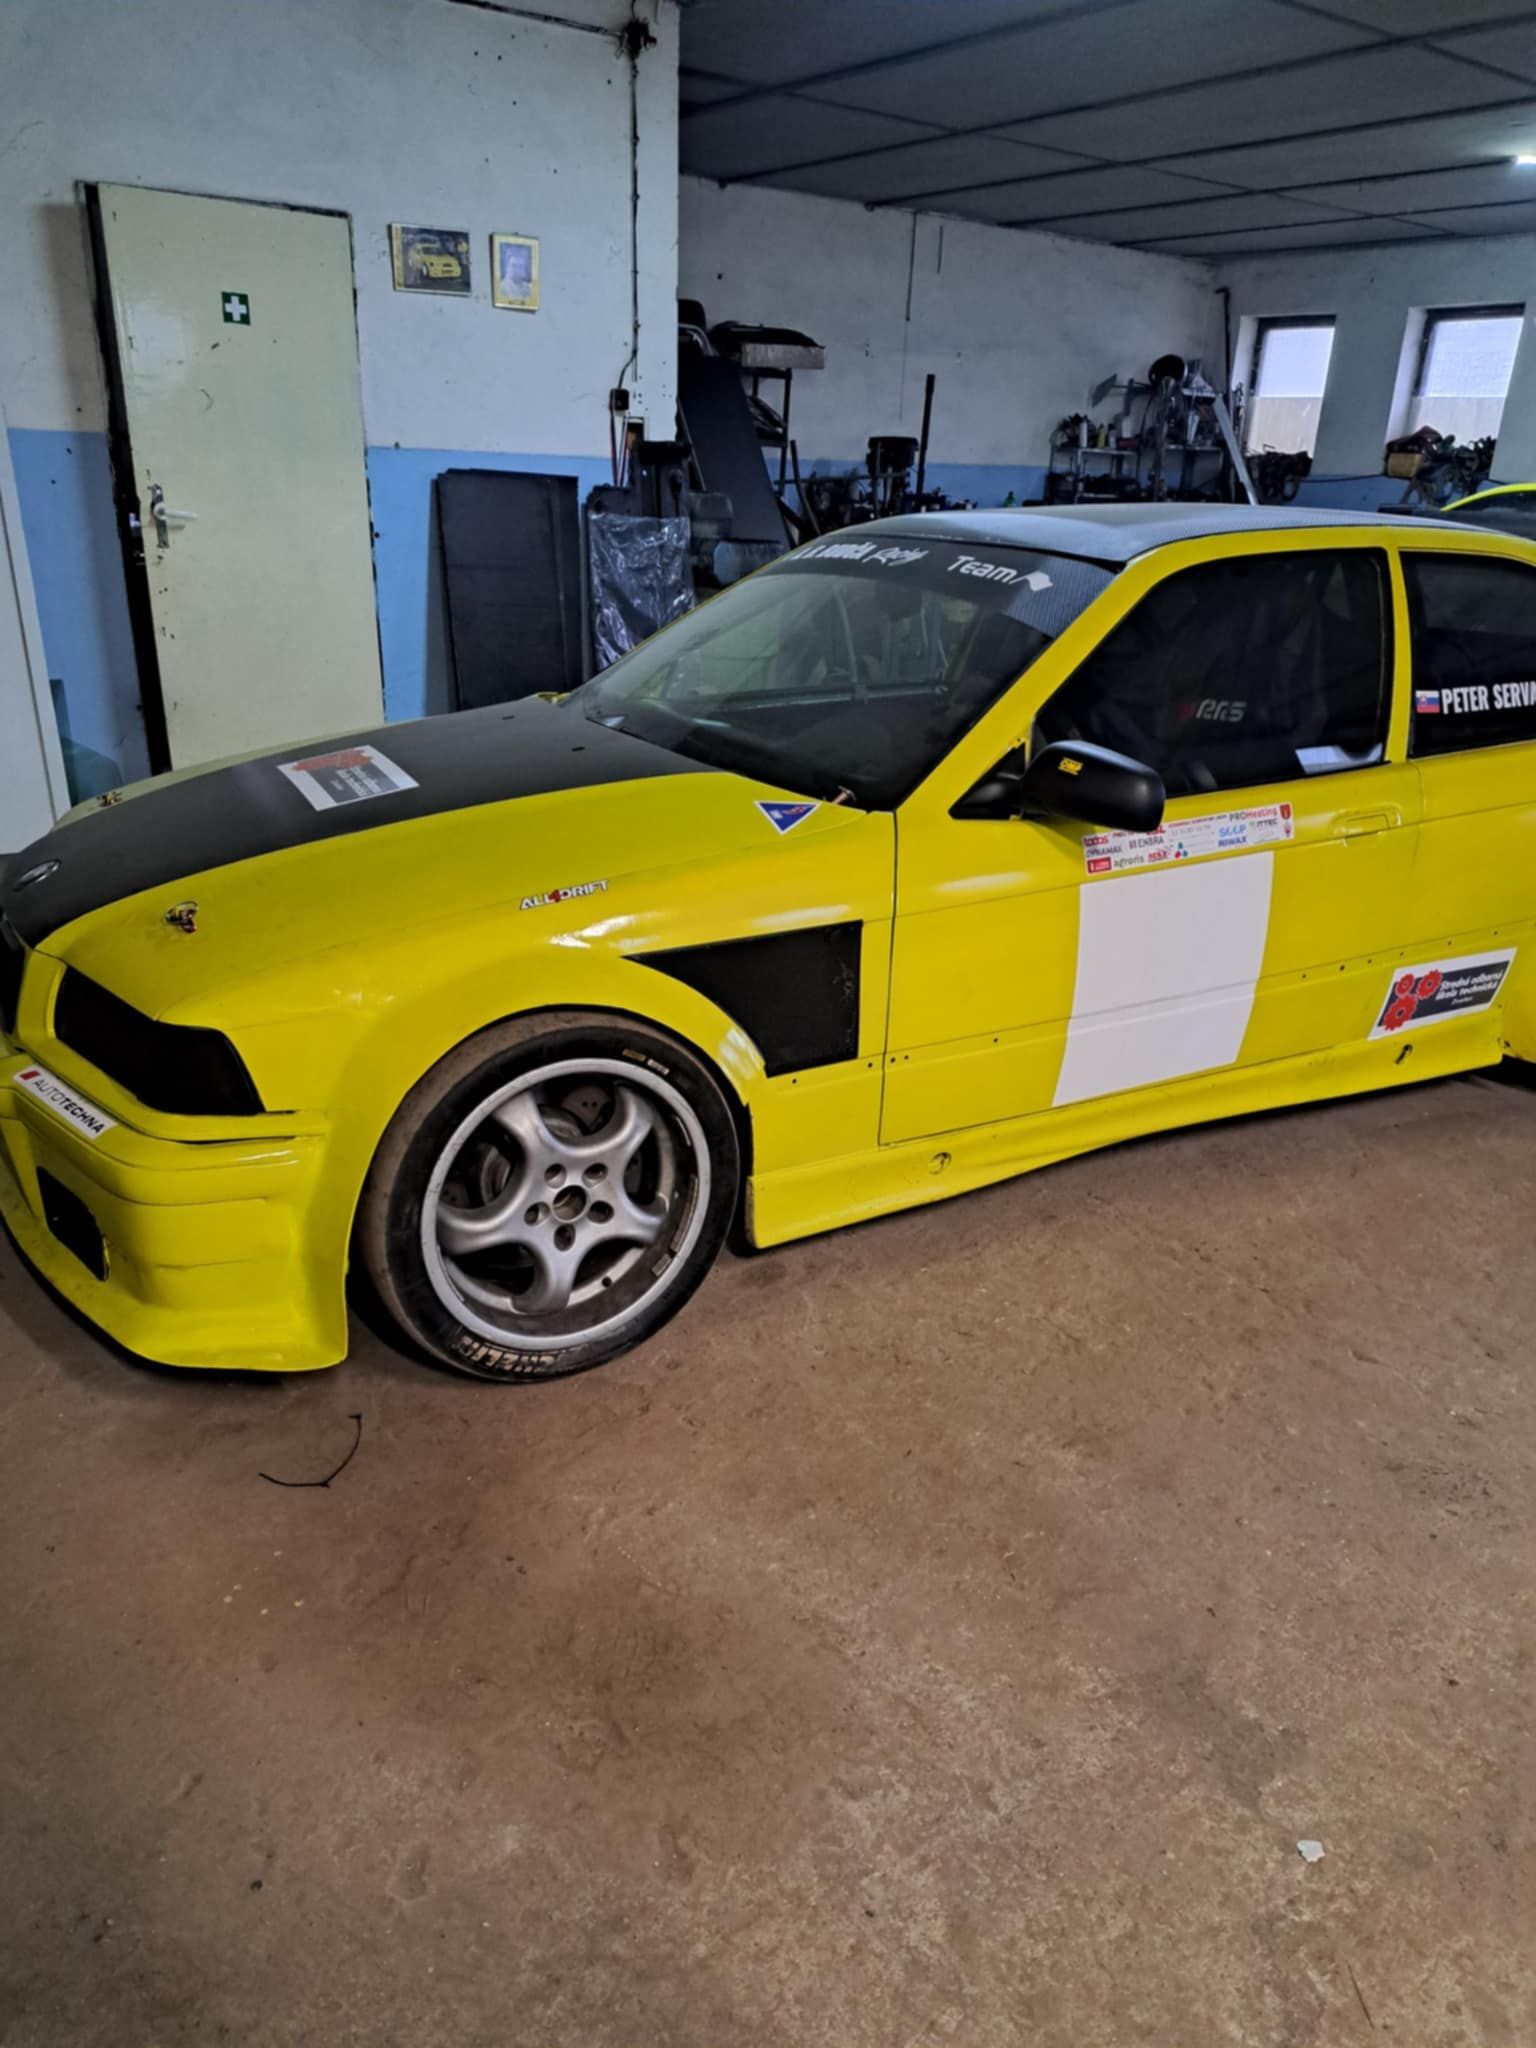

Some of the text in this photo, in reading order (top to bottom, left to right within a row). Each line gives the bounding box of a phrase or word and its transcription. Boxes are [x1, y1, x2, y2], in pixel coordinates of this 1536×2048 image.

[947, 555, 1018, 584] Team
[1441, 685, 1490, 714] PETER
[32, 1079, 106, 1134] AUTOTECHNA
